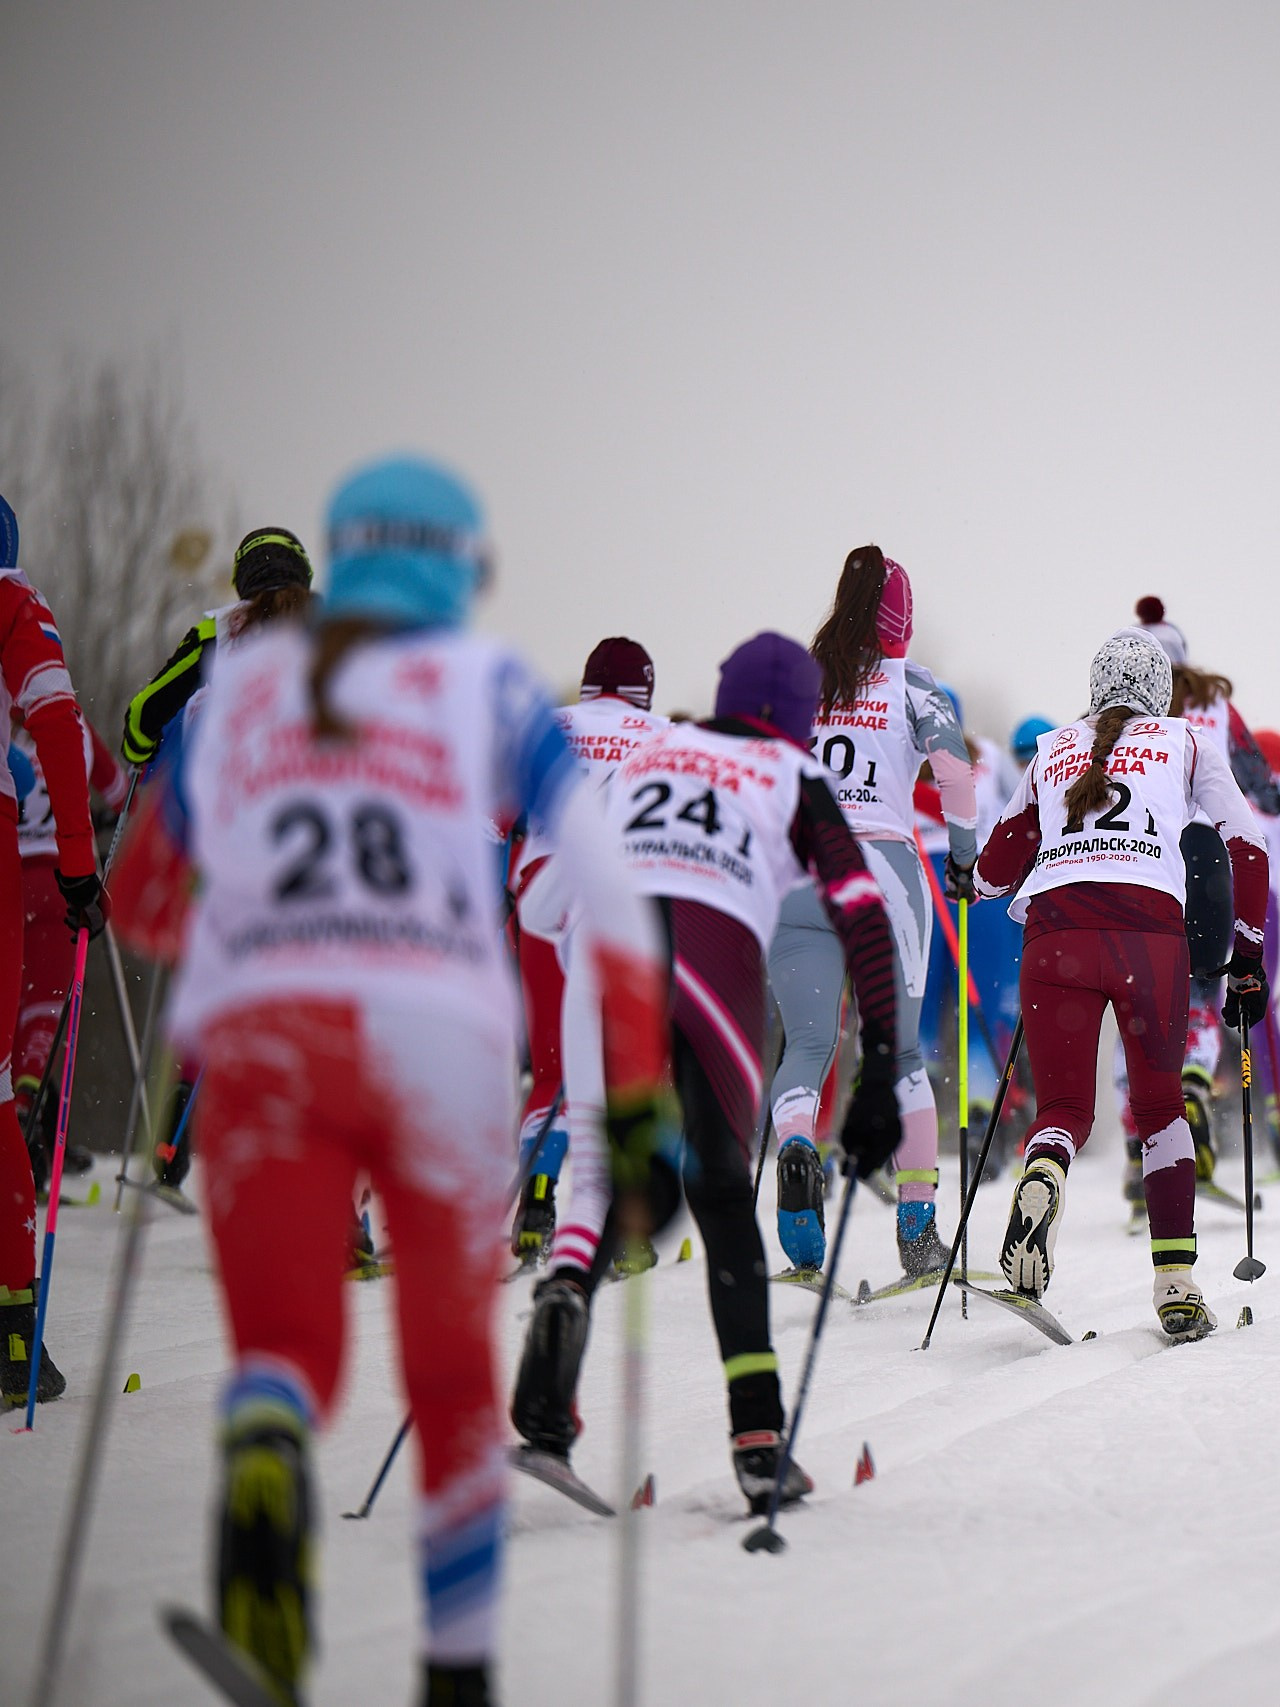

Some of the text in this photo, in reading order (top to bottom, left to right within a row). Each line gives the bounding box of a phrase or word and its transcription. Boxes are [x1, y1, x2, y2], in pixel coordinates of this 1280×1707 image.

[864, 761, 877, 787] 1
[624, 781, 721, 834] 24
[1144, 808, 1158, 836] 1
[268, 800, 411, 900] 28
[1086, 853, 1131, 863] 1950-2020
